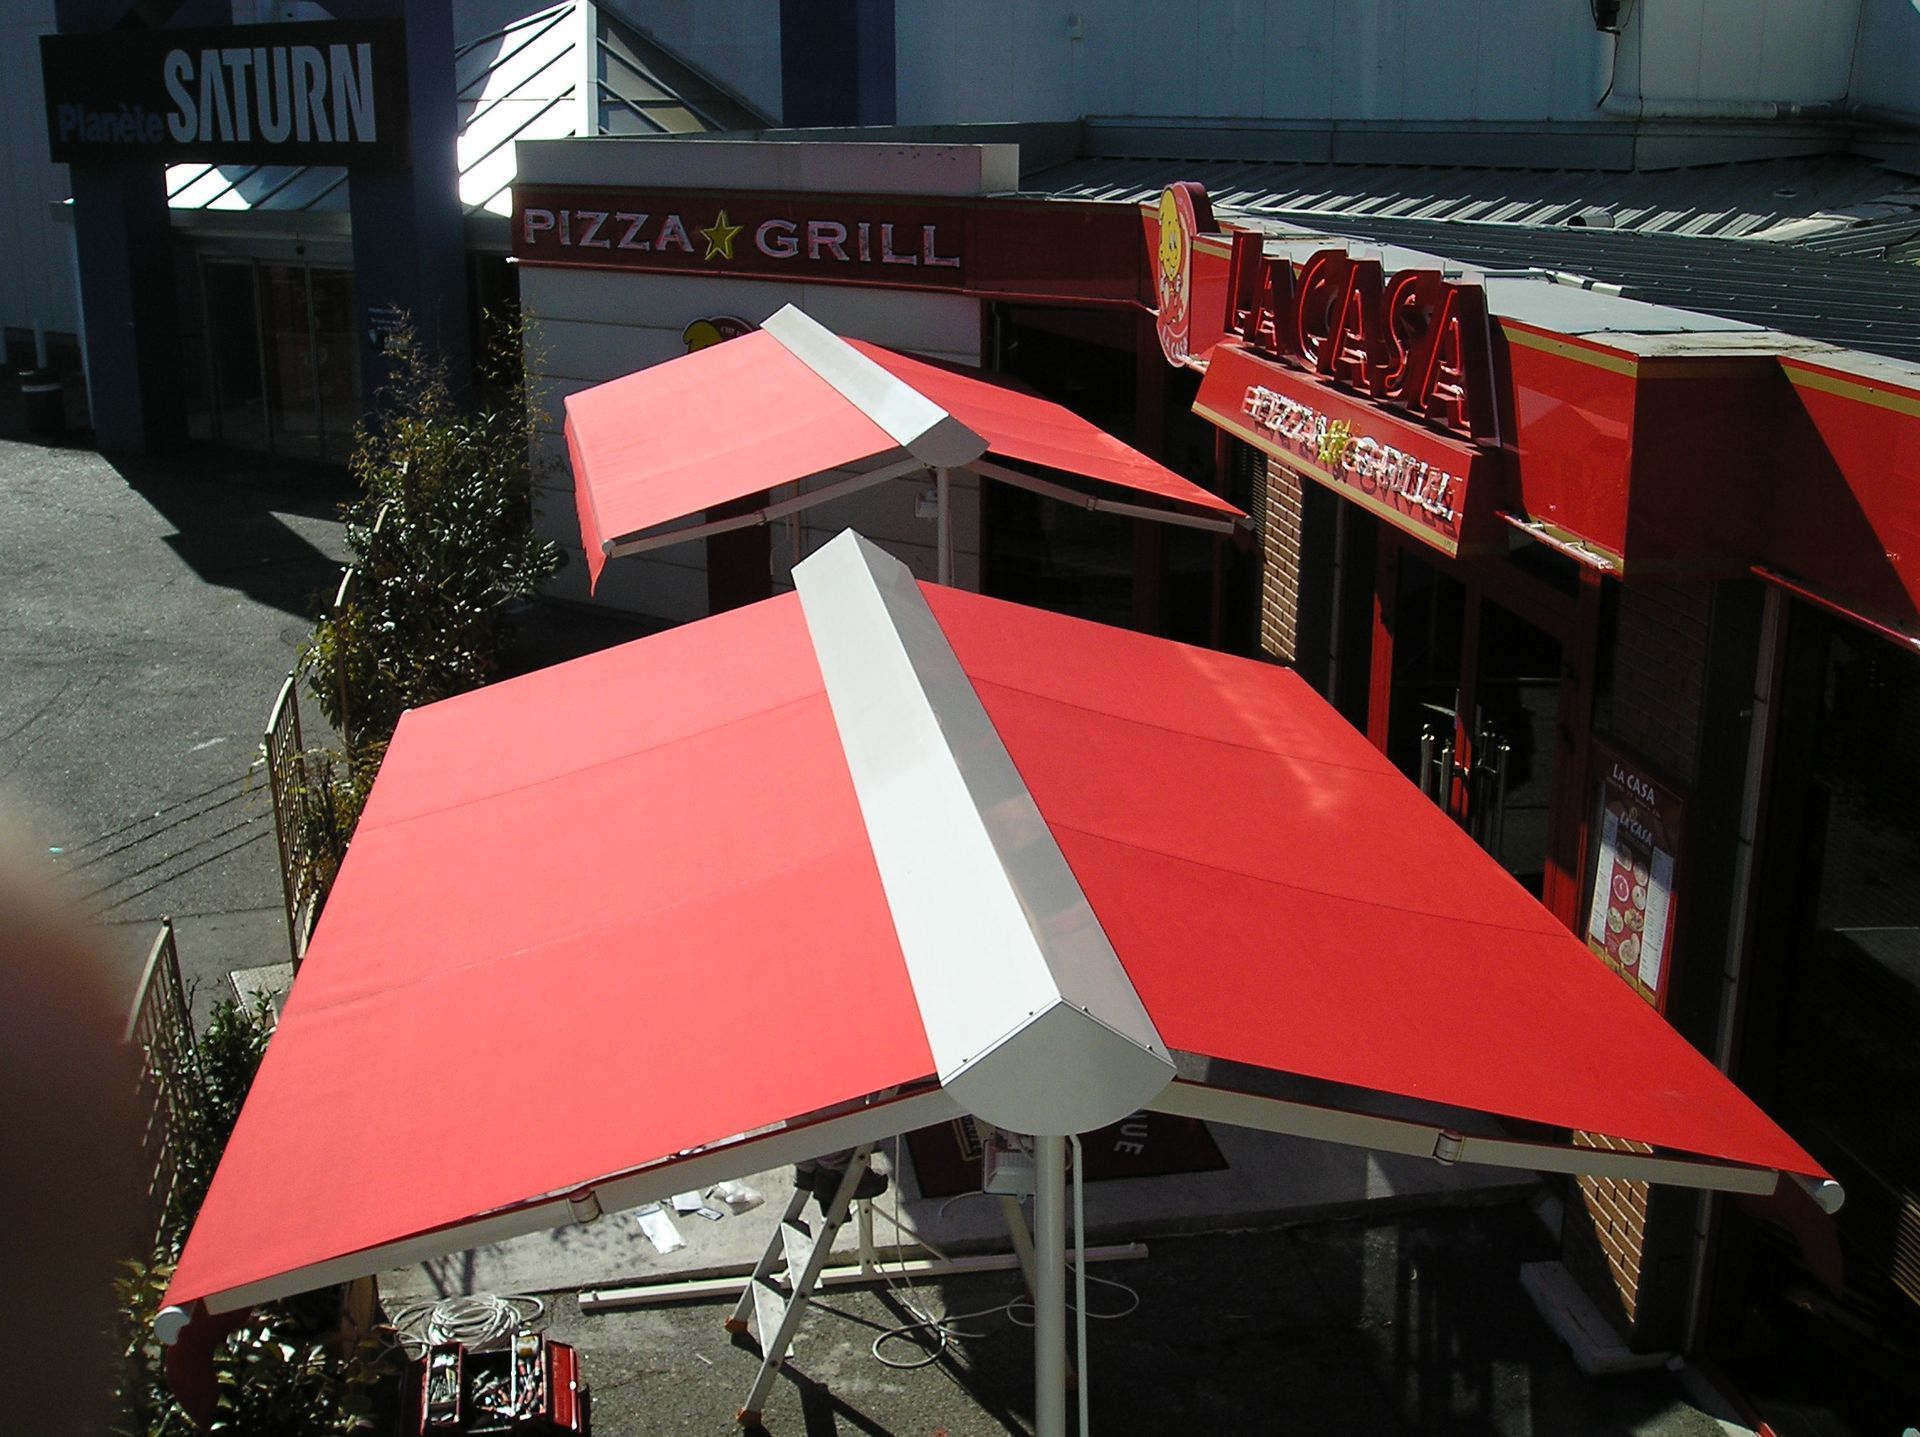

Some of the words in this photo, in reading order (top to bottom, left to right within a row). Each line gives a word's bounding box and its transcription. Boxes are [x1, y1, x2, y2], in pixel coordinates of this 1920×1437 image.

[58, 104, 163, 143] Planète
[164, 43, 376, 143] SATURN
[524, 208, 695, 253] PIZZA
[755, 219, 960, 268] GRILL
[1296, 248, 1502, 447] CASA
[1612, 763, 1625, 785] LA
[1626, 773, 1656, 806] CASA
[1619, 811, 1630, 829] LA
[1630, 821, 1653, 847] CASA
